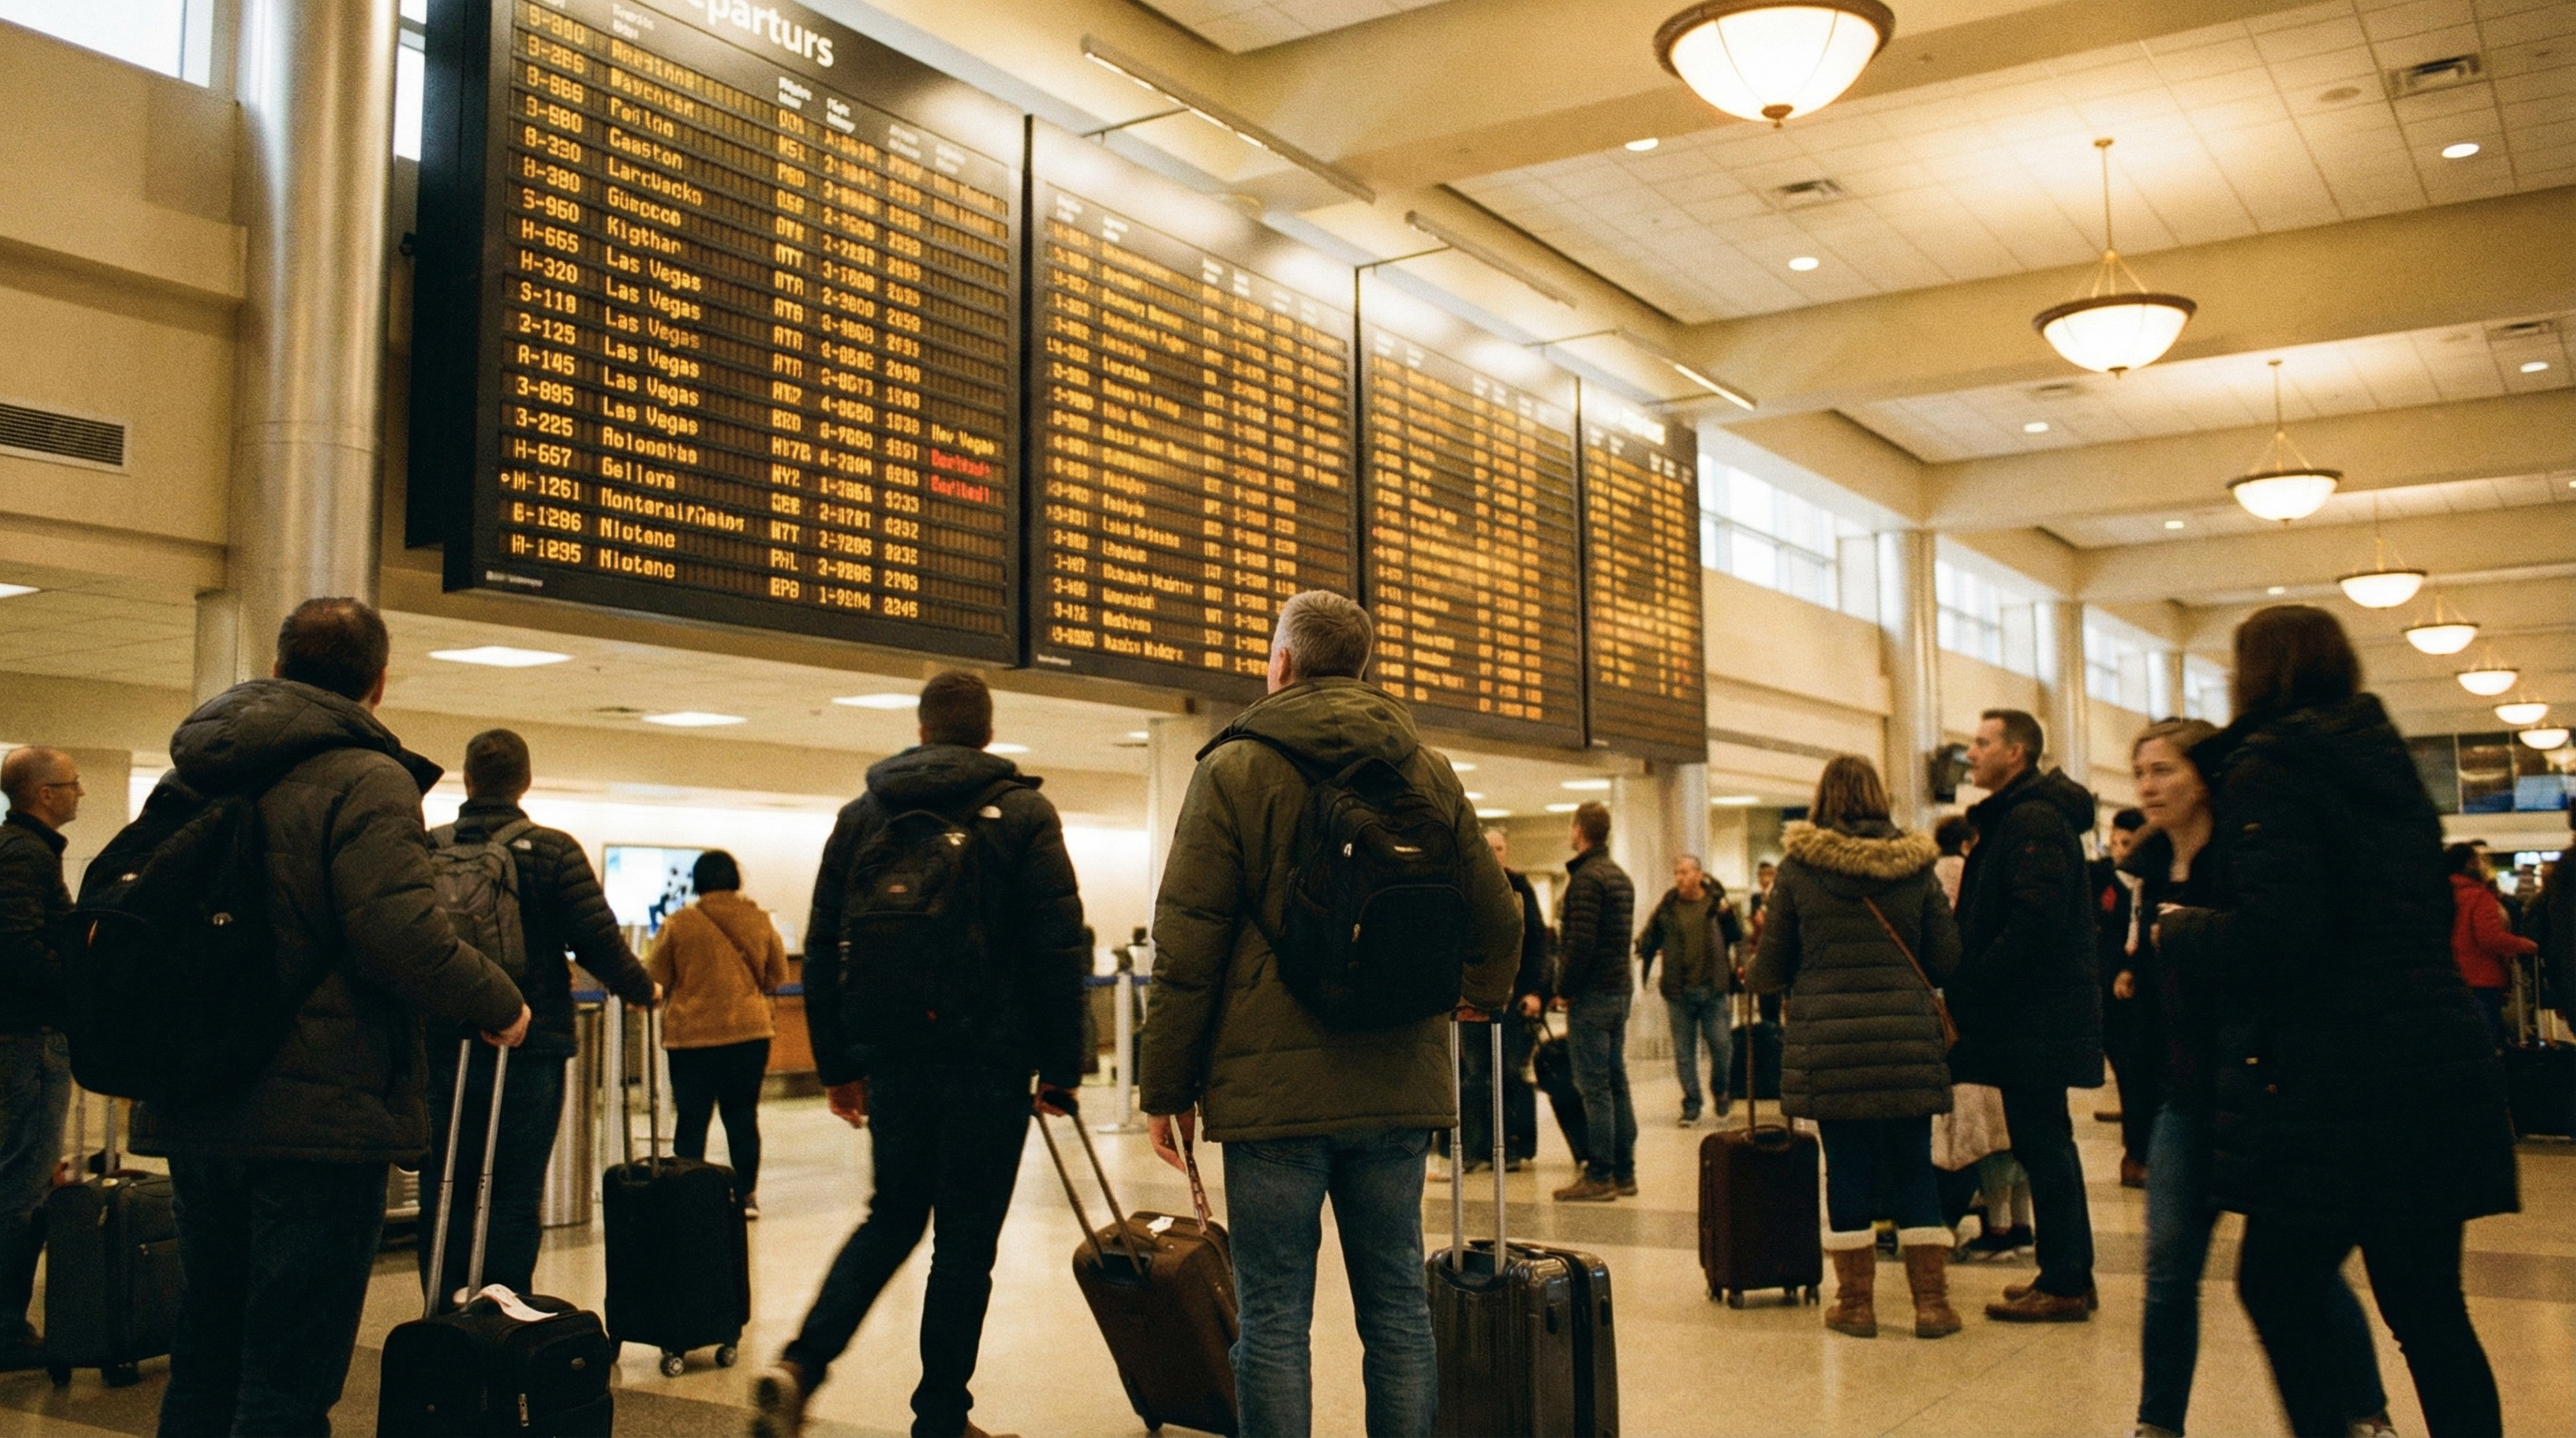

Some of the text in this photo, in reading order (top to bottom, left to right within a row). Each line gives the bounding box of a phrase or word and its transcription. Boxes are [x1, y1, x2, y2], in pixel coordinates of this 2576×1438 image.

[522, 219, 579, 254] H-665
[607, 246, 639, 272] Las
[650, 259, 702, 291] Vegas
[521, 250, 579, 285] H-320
[606, 276, 639, 301] Las
[649, 289, 701, 320] Vegas
[605, 306, 638, 331] Las
[648, 318, 701, 349] Vegas
[604, 336, 637, 361] Las
[648, 347, 700, 377] Vegas
[518, 375, 576, 406] 3-895
[603, 396, 637, 420] Las
[646, 407, 699, 435] Vegas
[603, 366, 637, 390] Las
[647, 377, 699, 406] Vegas
[517, 407, 575, 437] 3-225
